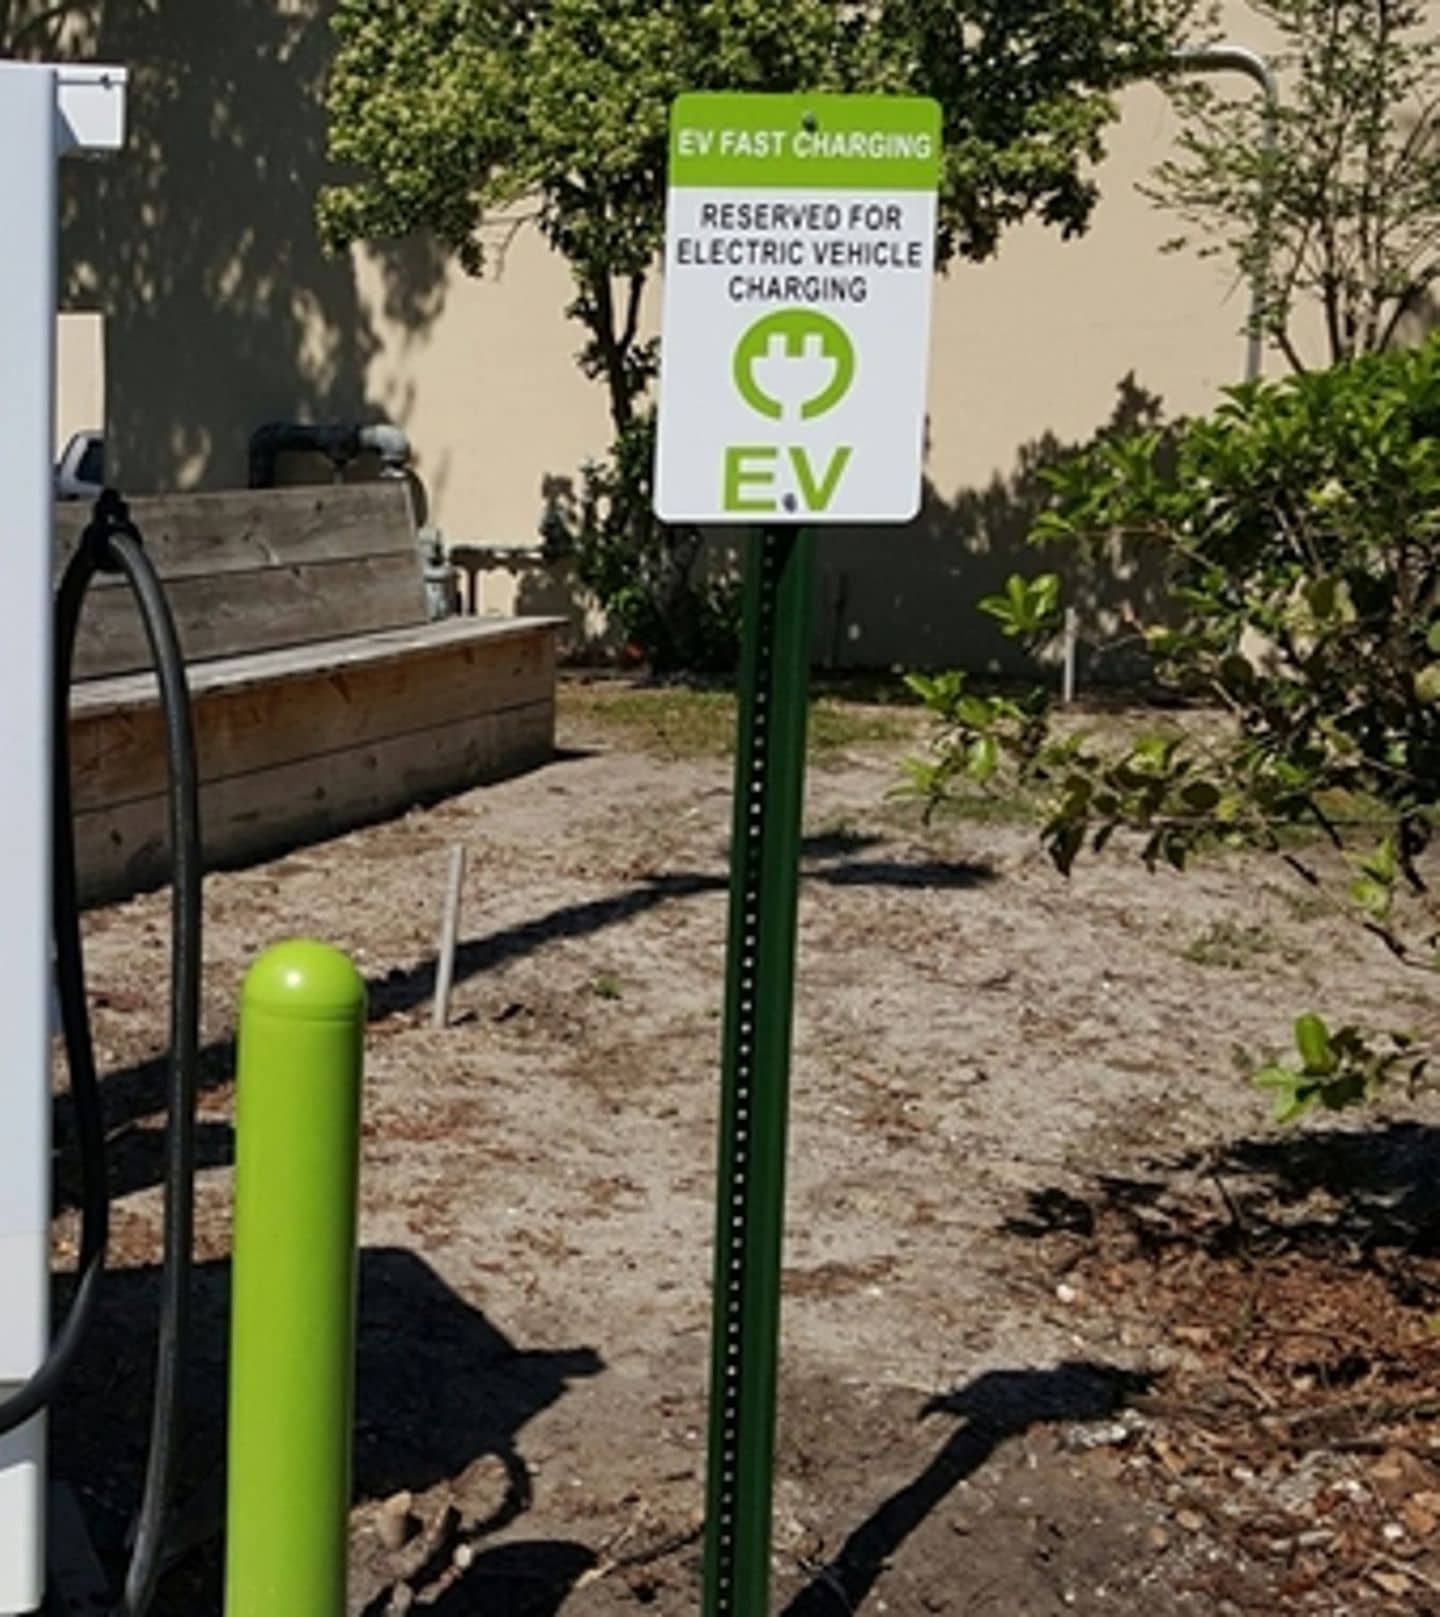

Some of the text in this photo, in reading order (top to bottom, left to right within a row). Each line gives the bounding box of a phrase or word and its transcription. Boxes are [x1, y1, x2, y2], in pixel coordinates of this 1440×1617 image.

[677, 129, 932, 159] EV FAST CHARGING
[700, 203, 902, 230] RESERVED FOR
[677, 239, 922, 267] ELECTRIC VEHICLE
[728, 276, 867, 302] CHARGING
[721, 446, 853, 513] EV
